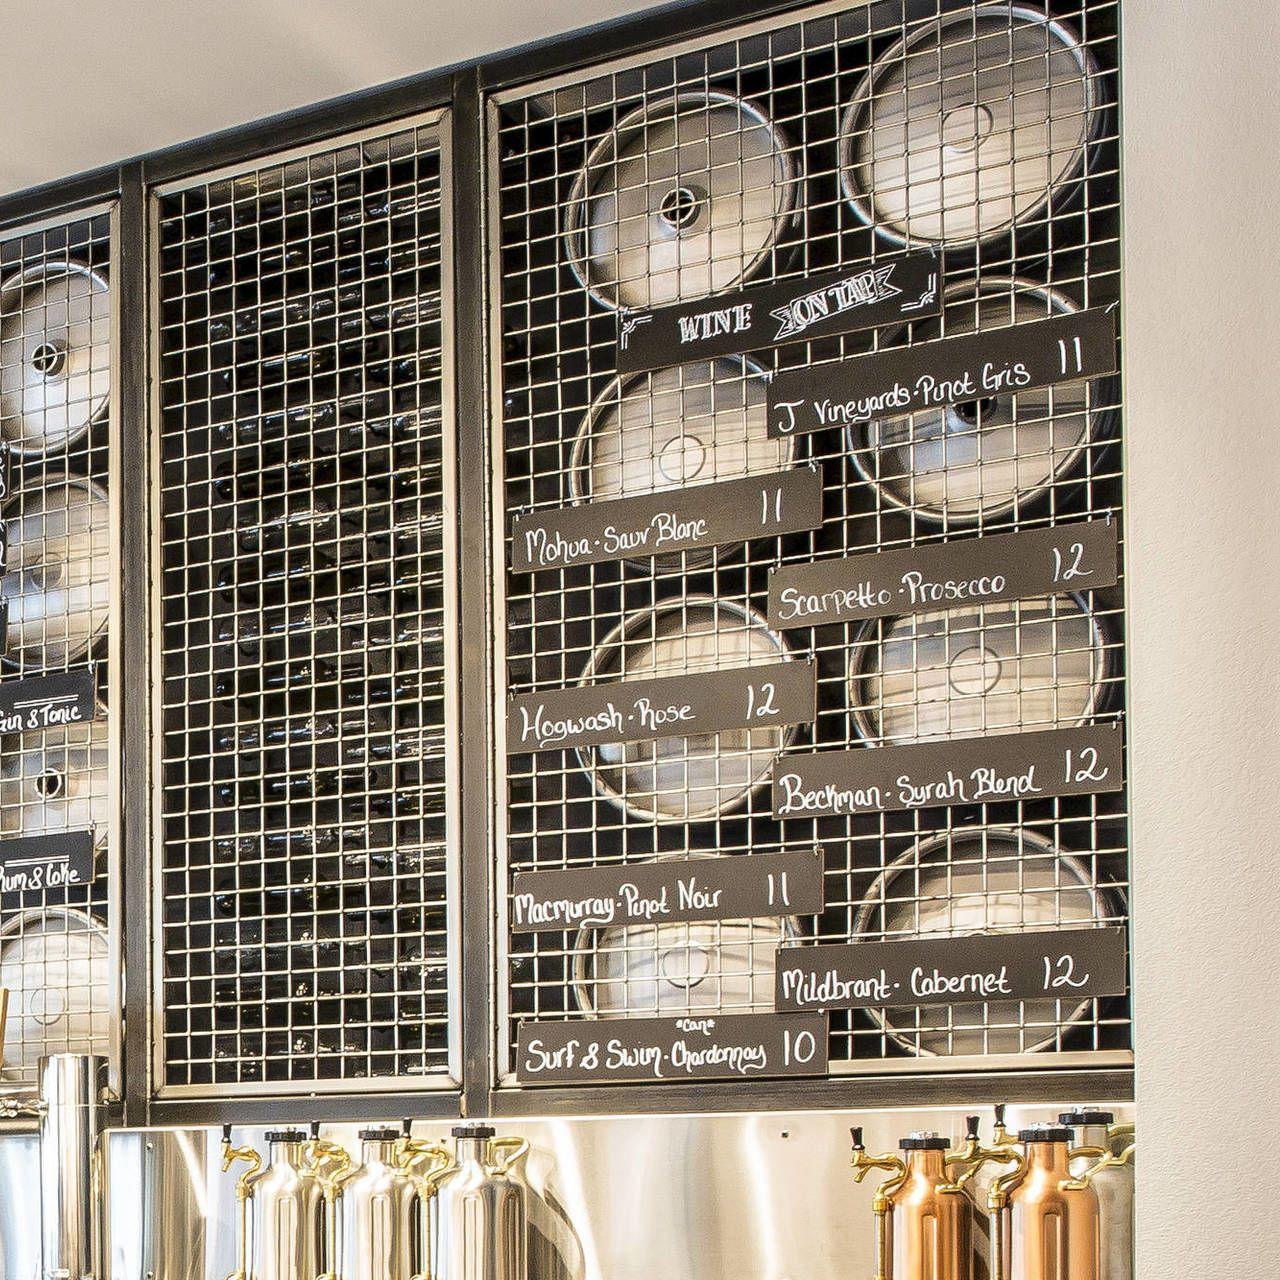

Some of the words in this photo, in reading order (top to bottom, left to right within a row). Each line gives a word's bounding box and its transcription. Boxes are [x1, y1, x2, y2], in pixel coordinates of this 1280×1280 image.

[677, 303, 753, 345] WINE
[791, 290, 828, 329] ON
[828, 271, 876, 312] TAP
[774, 399, 805, 433] J
[814, 383, 911, 421] Vineyards
[916, 372, 976, 405] Pinot
[982, 362, 1031, 391] Gris
[1058, 337, 1082, 375] 11
[526, 528, 593, 566] Mohua
[604, 525, 650, 554] Sauv
[651, 512, 709, 547] Blanc
[761, 488, 782, 524] 11
[902, 570, 1006, 606] Prosecco
[1052, 543, 1094, 583] 12
[39, 703, 82, 726] Tonic
[520, 702, 624, 748] Hogwash
[633, 697, 696, 732] Rose
[746, 682, 780, 720] 12
[778, 773, 884, 815] Beckman
[896, 770, 968, 808] Syrah
[971, 765, 1042, 800] Blend
[1065, 746, 1108, 783] 12
[45, 863, 81, 886] Coke
[619, 882, 671, 919] Pinot
[677, 876, 722, 911] Noir
[767, 871, 790, 906] 11
[782, 967, 892, 1005] Mildbrant
[911, 965, 1012, 997] Cabernet
[1042, 954, 1089, 990] 12
[525, 1038, 580, 1073] Surf
[605, 1038, 664, 1078] Swim
[671, 1040, 767, 1075] Chardonnay
[783, 1030, 815, 1066] 10
